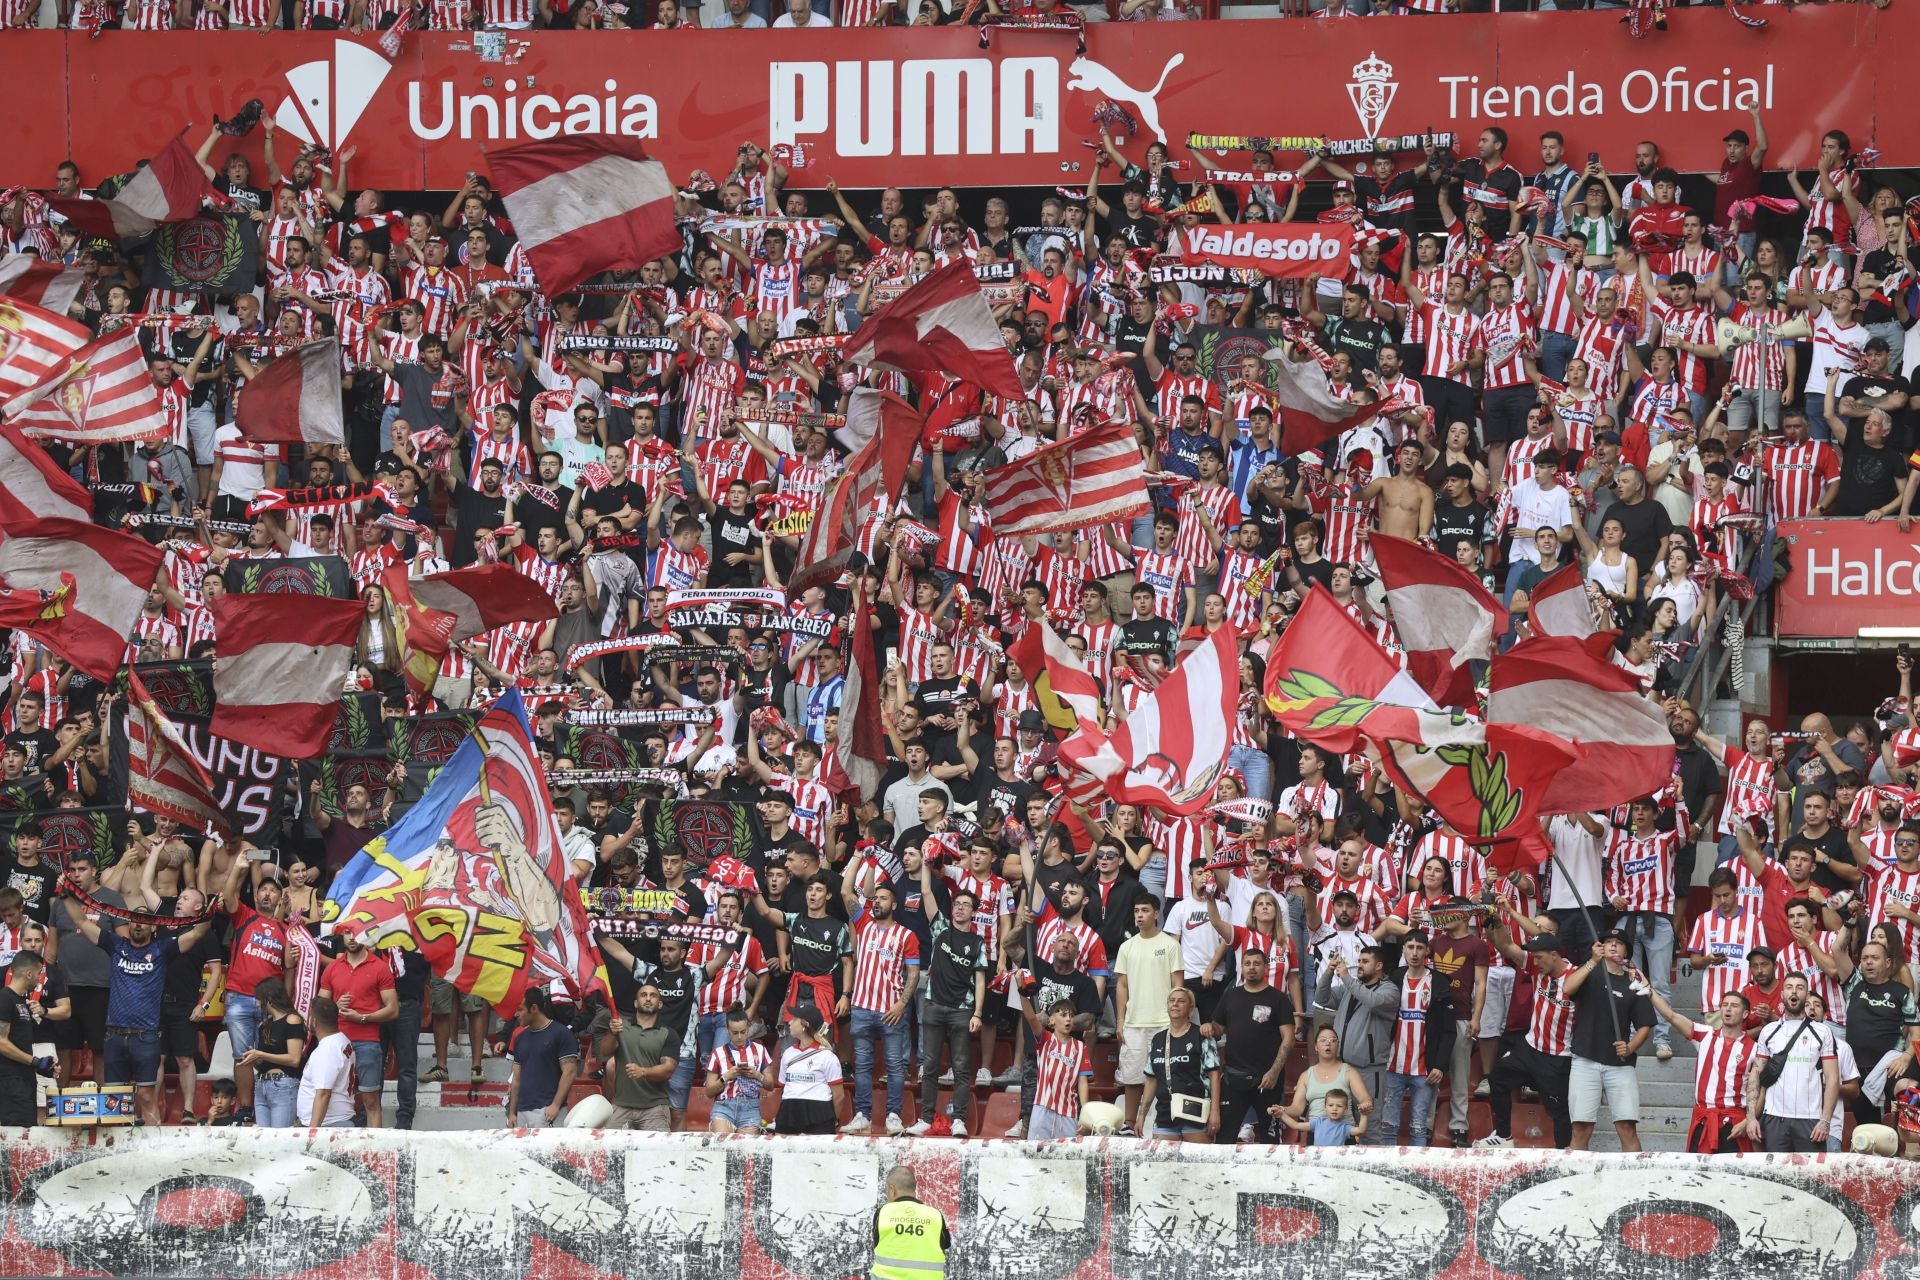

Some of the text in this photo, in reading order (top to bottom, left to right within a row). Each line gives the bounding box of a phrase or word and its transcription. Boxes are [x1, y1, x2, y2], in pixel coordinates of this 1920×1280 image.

[1439, 71, 1604, 118] Tienda
[1621, 64, 1773, 113] Oficial
[409, 79, 658, 139] Unicaia
[770, 57, 1059, 157] PUMA
[1402, 135, 1422, 149] ON
[1187, 226, 1341, 263] Valdesoto
[1340, 335, 1375, 350] SIROKO
[681, 590, 774, 600] PEÑA MEDIU POLLO
[668, 610, 831, 638] SALVAJES LANGREO
[632, 889, 677, 911] BOYS
[1881, 886, 1919, 902] JALISCO
[666, 925, 739, 944] OVIEDO
[793, 936, 833, 952] SIROKO
[117, 957, 154, 972] JALISCO
[299, 982, 314, 1013] CESAR
[889, 1216, 931, 1226] PROSEGUR
[895, 1222, 925, 1238] 046
